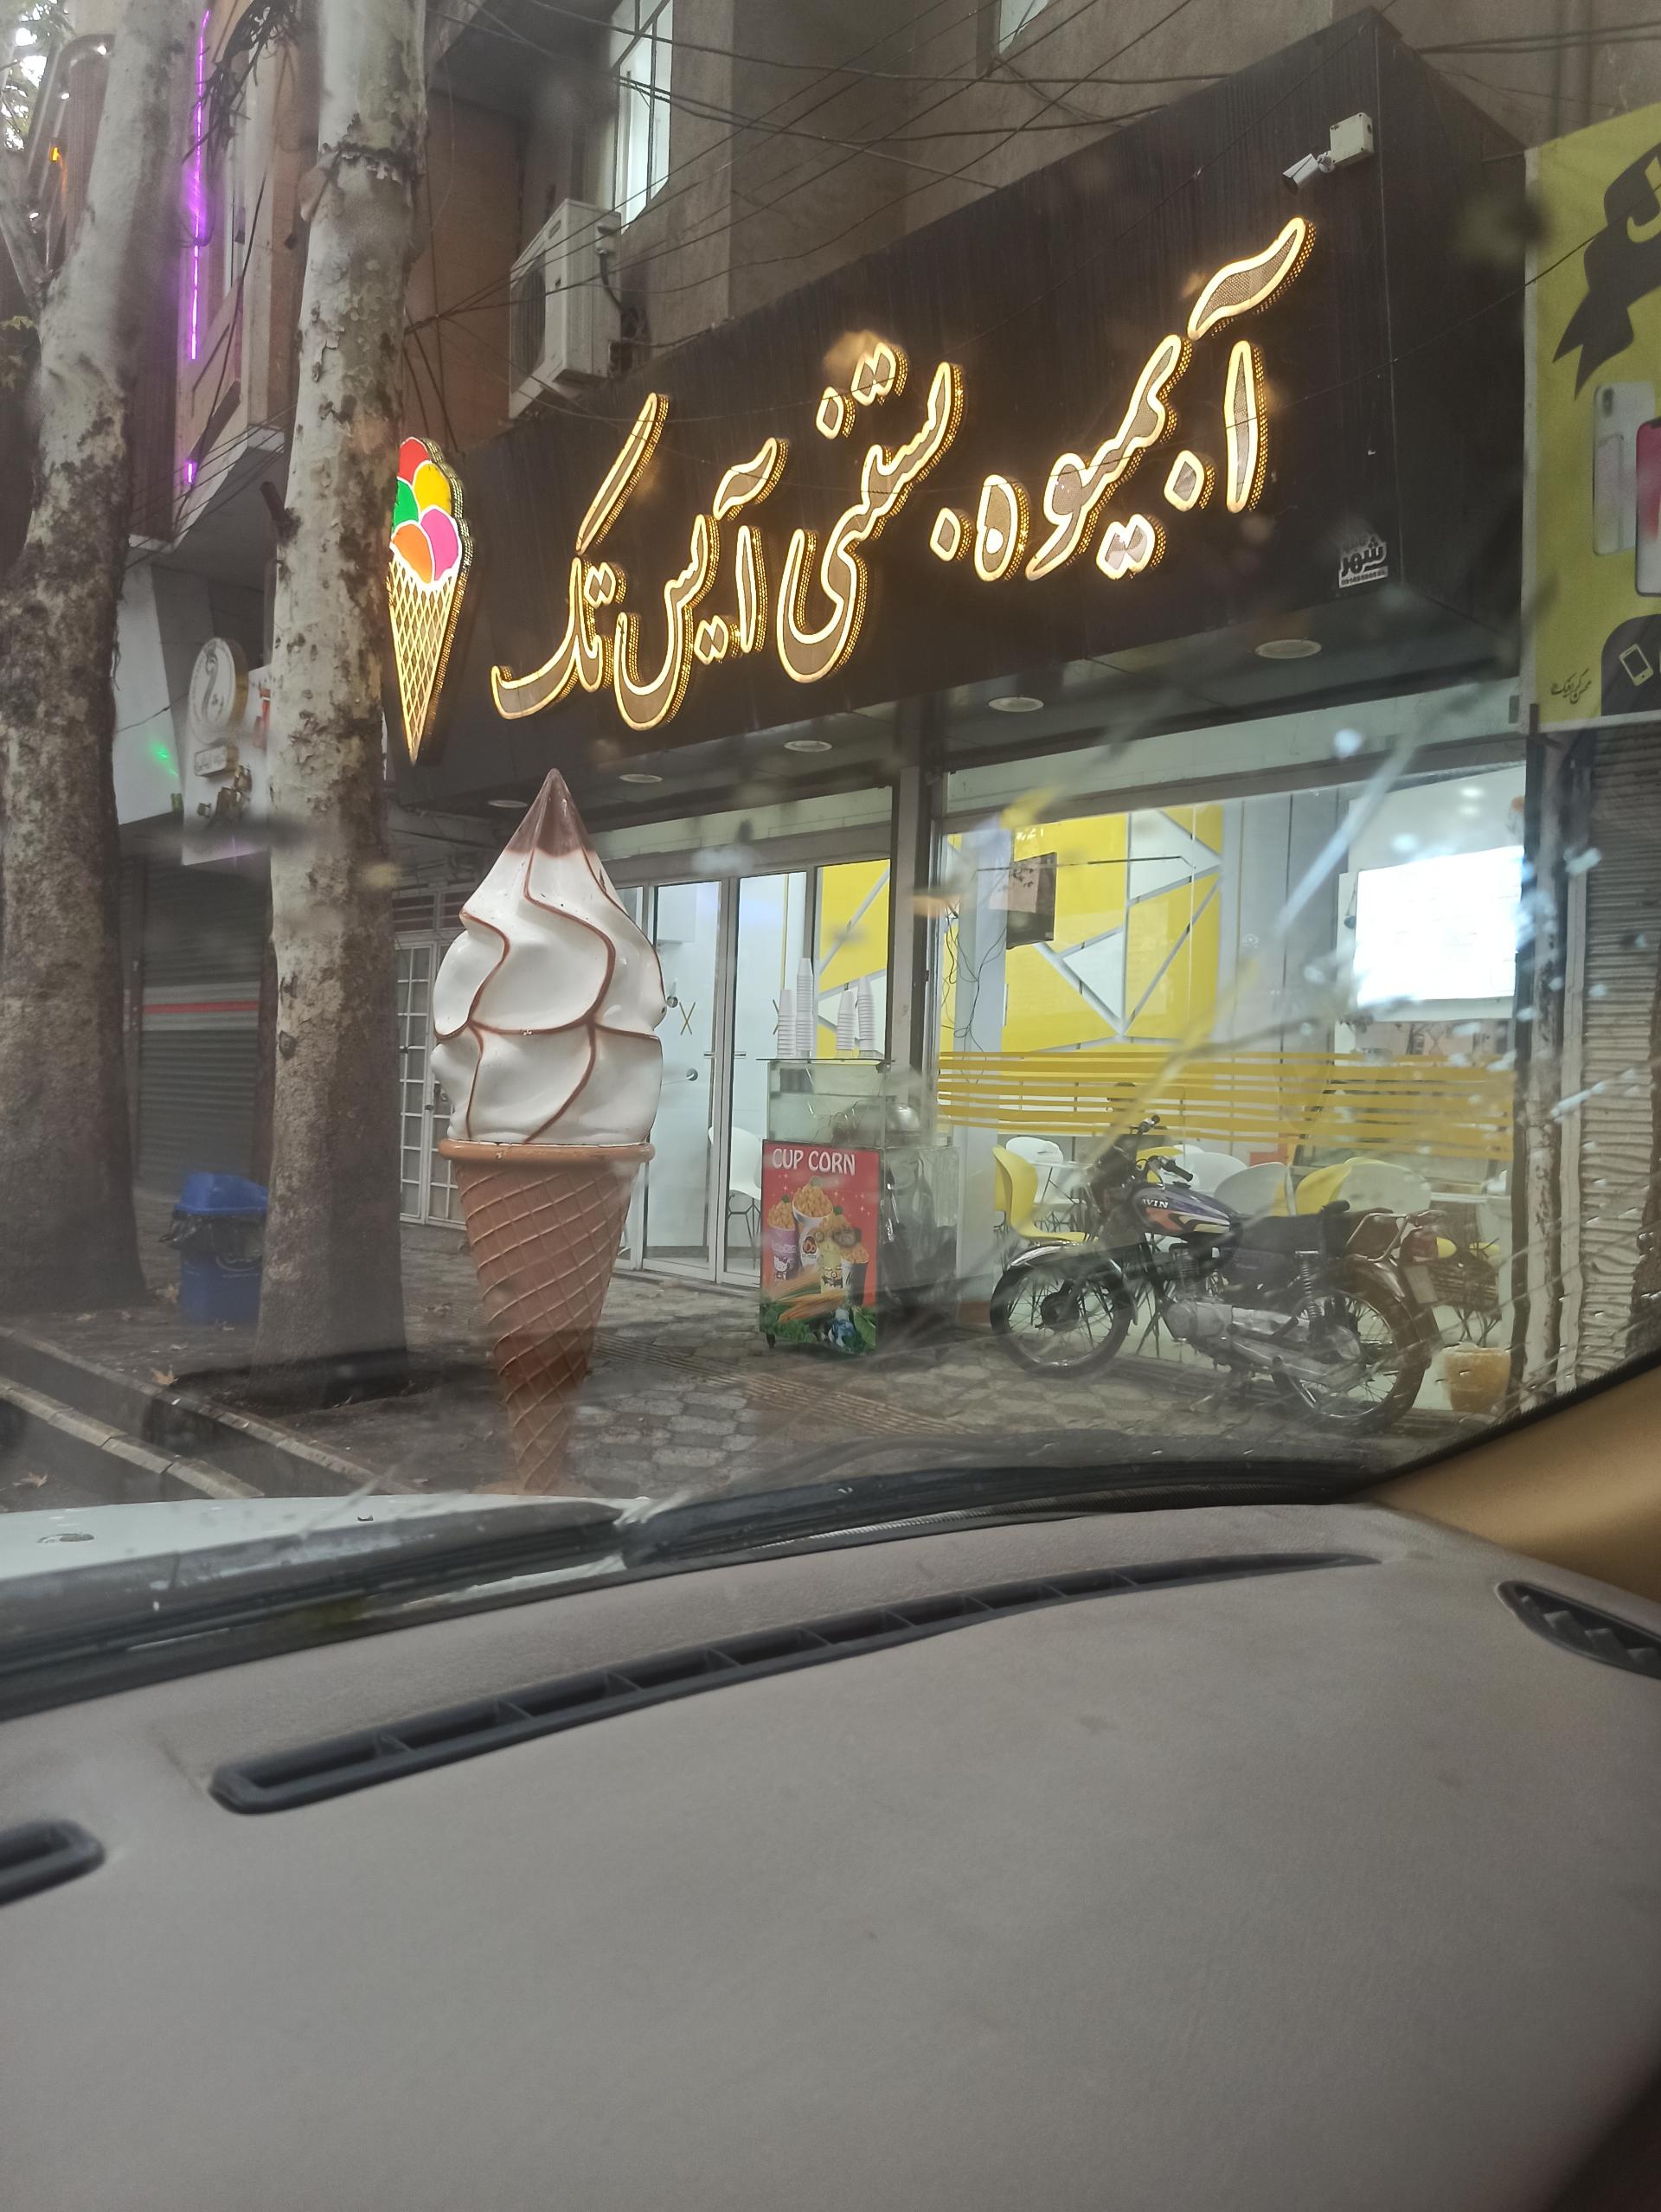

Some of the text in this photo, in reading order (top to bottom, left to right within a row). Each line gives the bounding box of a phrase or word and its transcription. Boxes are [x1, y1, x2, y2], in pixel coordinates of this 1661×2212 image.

[776, 341, 972, 685] بستنی
[976, 216, 1315, 581] آبمیوه
[612, 436, 791, 732] آیس
[1341, 536, 1384, 578] شهر
[773, 1148, 856, 1176] CUP CORN
